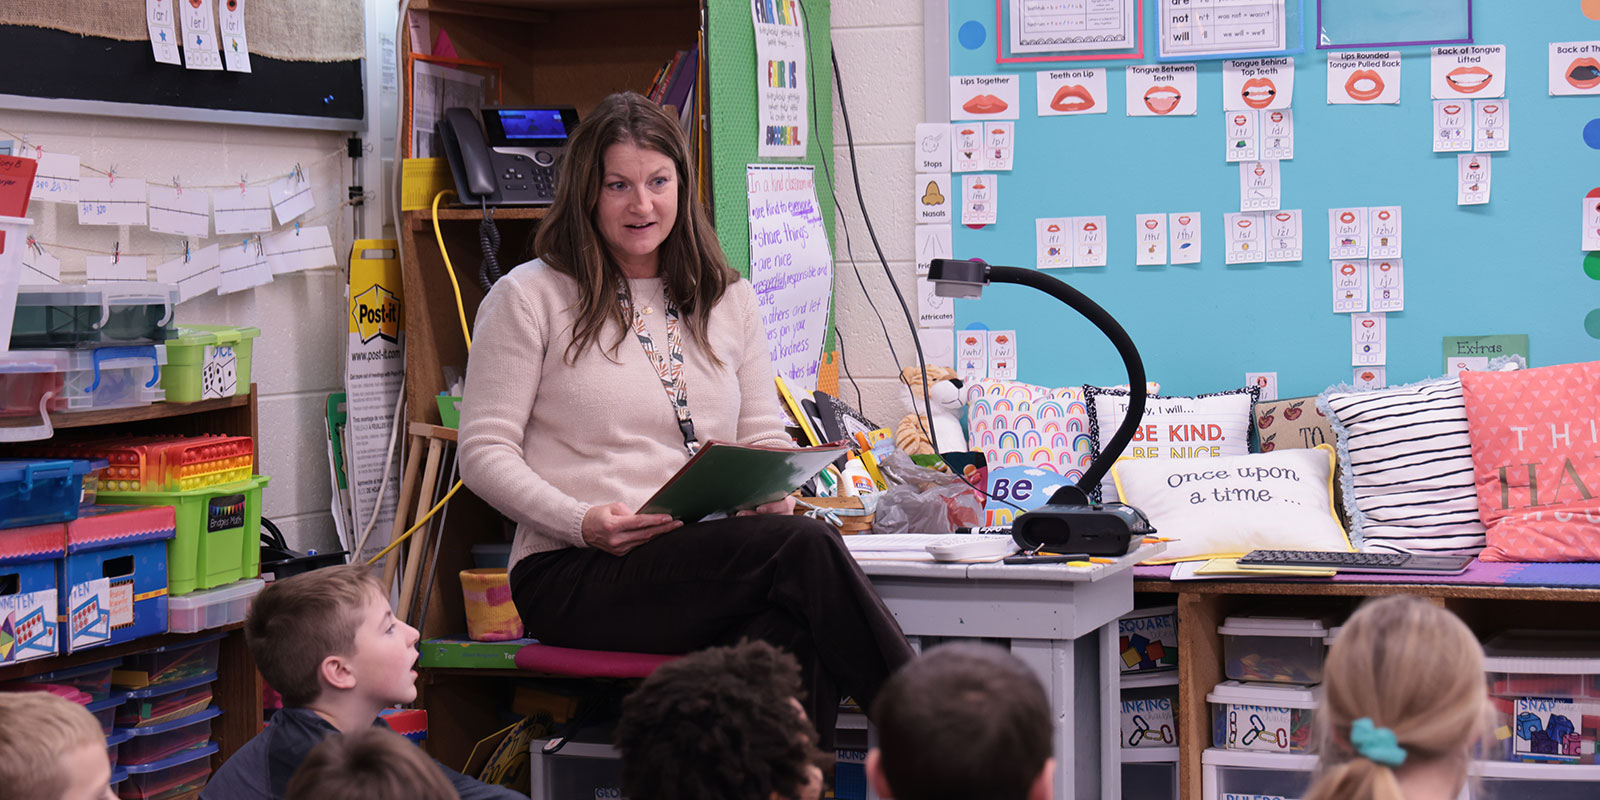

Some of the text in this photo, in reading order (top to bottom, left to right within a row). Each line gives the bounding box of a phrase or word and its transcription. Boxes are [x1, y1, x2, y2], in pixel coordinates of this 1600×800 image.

[1172, 14, 1189, 23] not
[1173, 32, 1190, 41] will
[1340, 52, 1390, 61] Lips Rounded
[1437, 47, 1459, 55] Back
[1471, 46, 1501, 55] Tongue
[1557, 46, 1578, 54] Back
[1232, 58, 1288, 68] Tongue Behind
[1329, 60, 1400, 69] Tongue Pulled Back
[1457, 56, 1481, 64] Lifted
[768, 60, 797, 89] FAIR IS
[1050, 72, 1070, 80] Teeth
[1083, 70, 1094, 79] Lip
[1132, 64, 1195, 75] Tongue Between
[1241, 67, 1278, 76] Top Teeth
[960, 76, 1010, 86] Lips Together
[924, 160, 942, 168] Stops
[748, 172, 760, 194] In
[764, 180, 769, 192] a
[755, 206, 765, 220] are
[766, 200, 780, 216] kind
[780, 200, 787, 213] to
[758, 222, 809, 249] share things
[758, 252, 792, 272] are nice
[816, 262, 827, 276] and
[758, 293, 774, 306] safe
[360, 303, 396, 324] Post-it
[793, 302, 808, 317] and
[809, 298, 821, 312] let
[793, 320, 806, 338] you
[1457, 341, 1502, 354] Extras
[1119, 404, 1155, 416] Toy,
[1166, 405, 1194, 414] will...
[1132, 424, 1226, 442] BE KIND.
[1300, 426, 1325, 449] TO
[1168, 466, 1300, 488] Once upon
[992, 478, 1032, 501] Be
[1190, 491, 1206, 504] a
[1212, 488, 1272, 502] time
[210, 516, 242, 529] Bridges Math
[73, 582, 90, 598] TEN
[16, 592, 34, 609] TEN
[1120, 616, 1171, 632] SQUARE
[1120, 698, 1170, 713] INKING
[1520, 698, 1555, 712] SNAP
